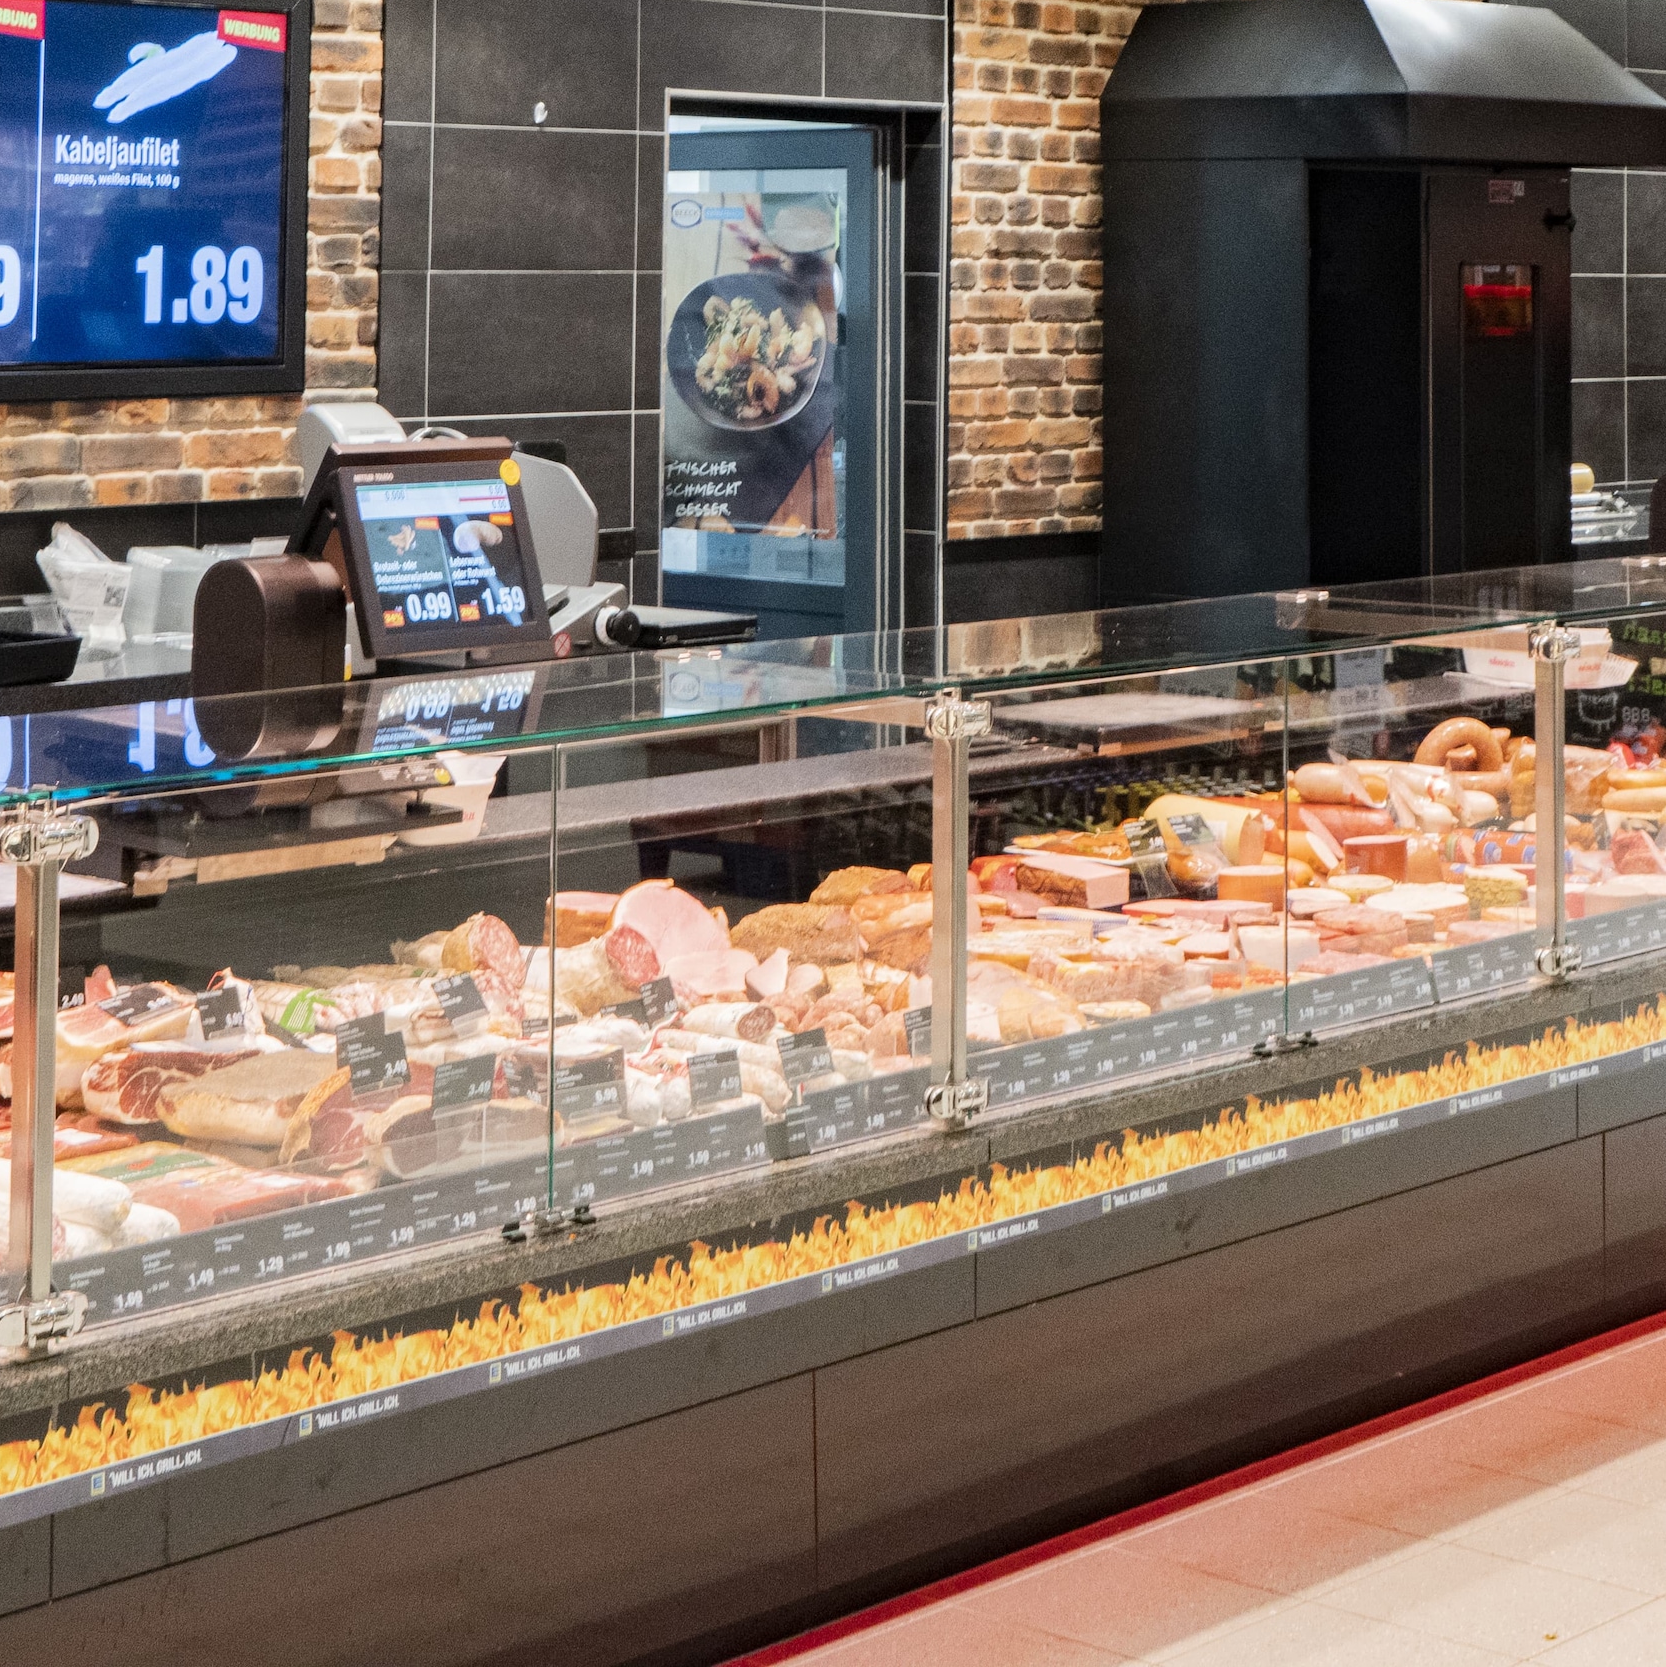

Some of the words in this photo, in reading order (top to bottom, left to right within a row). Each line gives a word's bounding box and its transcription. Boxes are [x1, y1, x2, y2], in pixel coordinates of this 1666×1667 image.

[224, 18, 281, 43] WERBUNG
[54, 133, 180, 169] Kabeljaufilet
[135, 245, 265, 325] 1.89
[665, 460, 737, 479] FRISCHER
[665, 481, 742, 497] SCHMECKT
[675, 502, 731, 517] BESSER.
[407, 592, 452, 622] 0.99
[482, 586, 526, 615] 1.59
[676, 1312, 697, 1331] WILL
[712, 1303, 733, 1322] GRILL
[504, 1357, 527, 1377] WILL
[542, 1347, 566, 1367] GRILL
[316, 1410, 339, 1429] WILL
[358, 1398, 383, 1419] GRILL
[110, 1468, 134, 1488] WILL
[137, 1462, 155, 1481] ICH.
[155, 1454, 183, 1477] GRILL
[183, 1449, 202, 1467] ICH.
